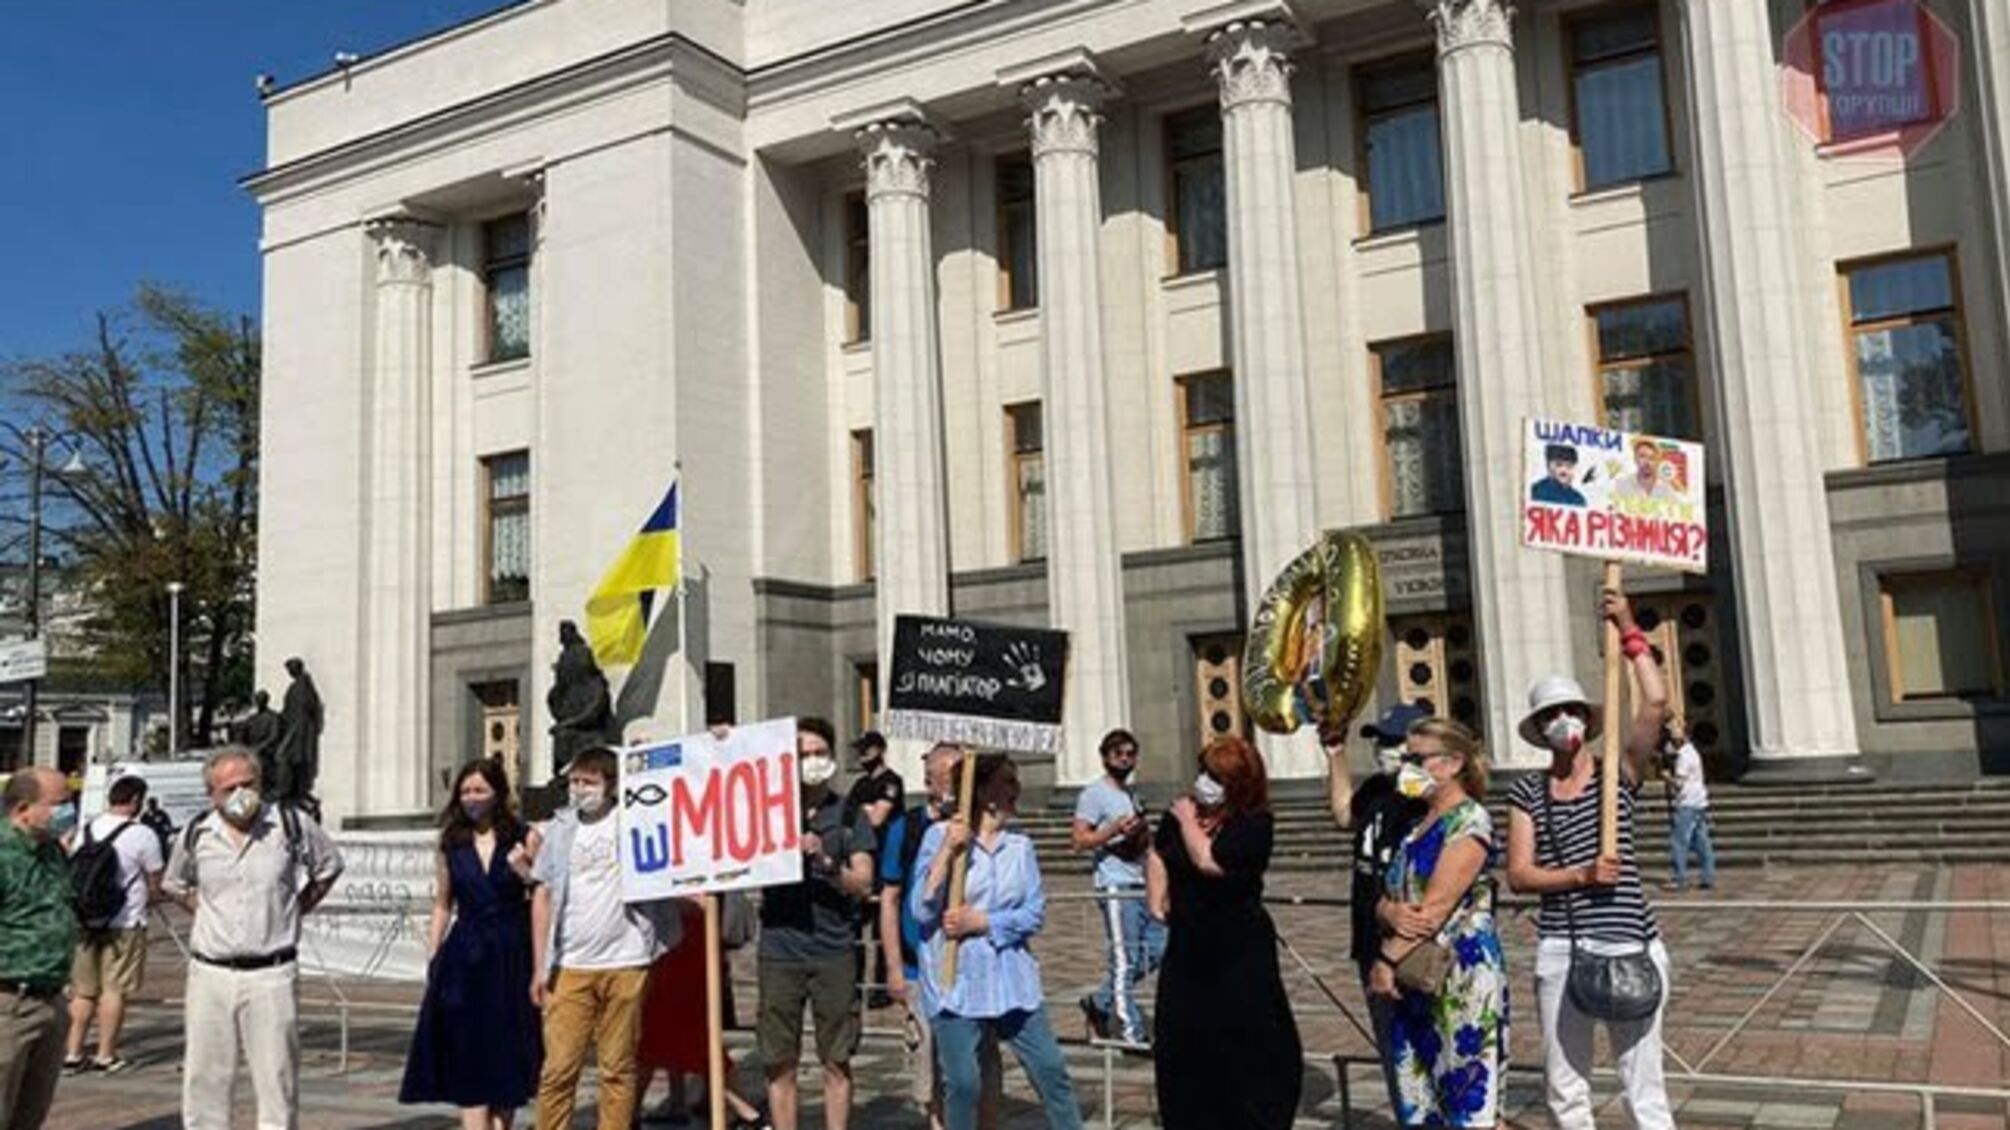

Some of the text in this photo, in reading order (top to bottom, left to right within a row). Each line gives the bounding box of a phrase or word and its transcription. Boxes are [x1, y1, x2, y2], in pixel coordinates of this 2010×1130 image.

[1534, 420, 1622, 451] ШАПКИ
[1527, 506, 1580, 545] ЯКА
[1586, 504, 1706, 561] РІЗНИЦЯ?
[917, 648, 975, 667] ЧОМУ
